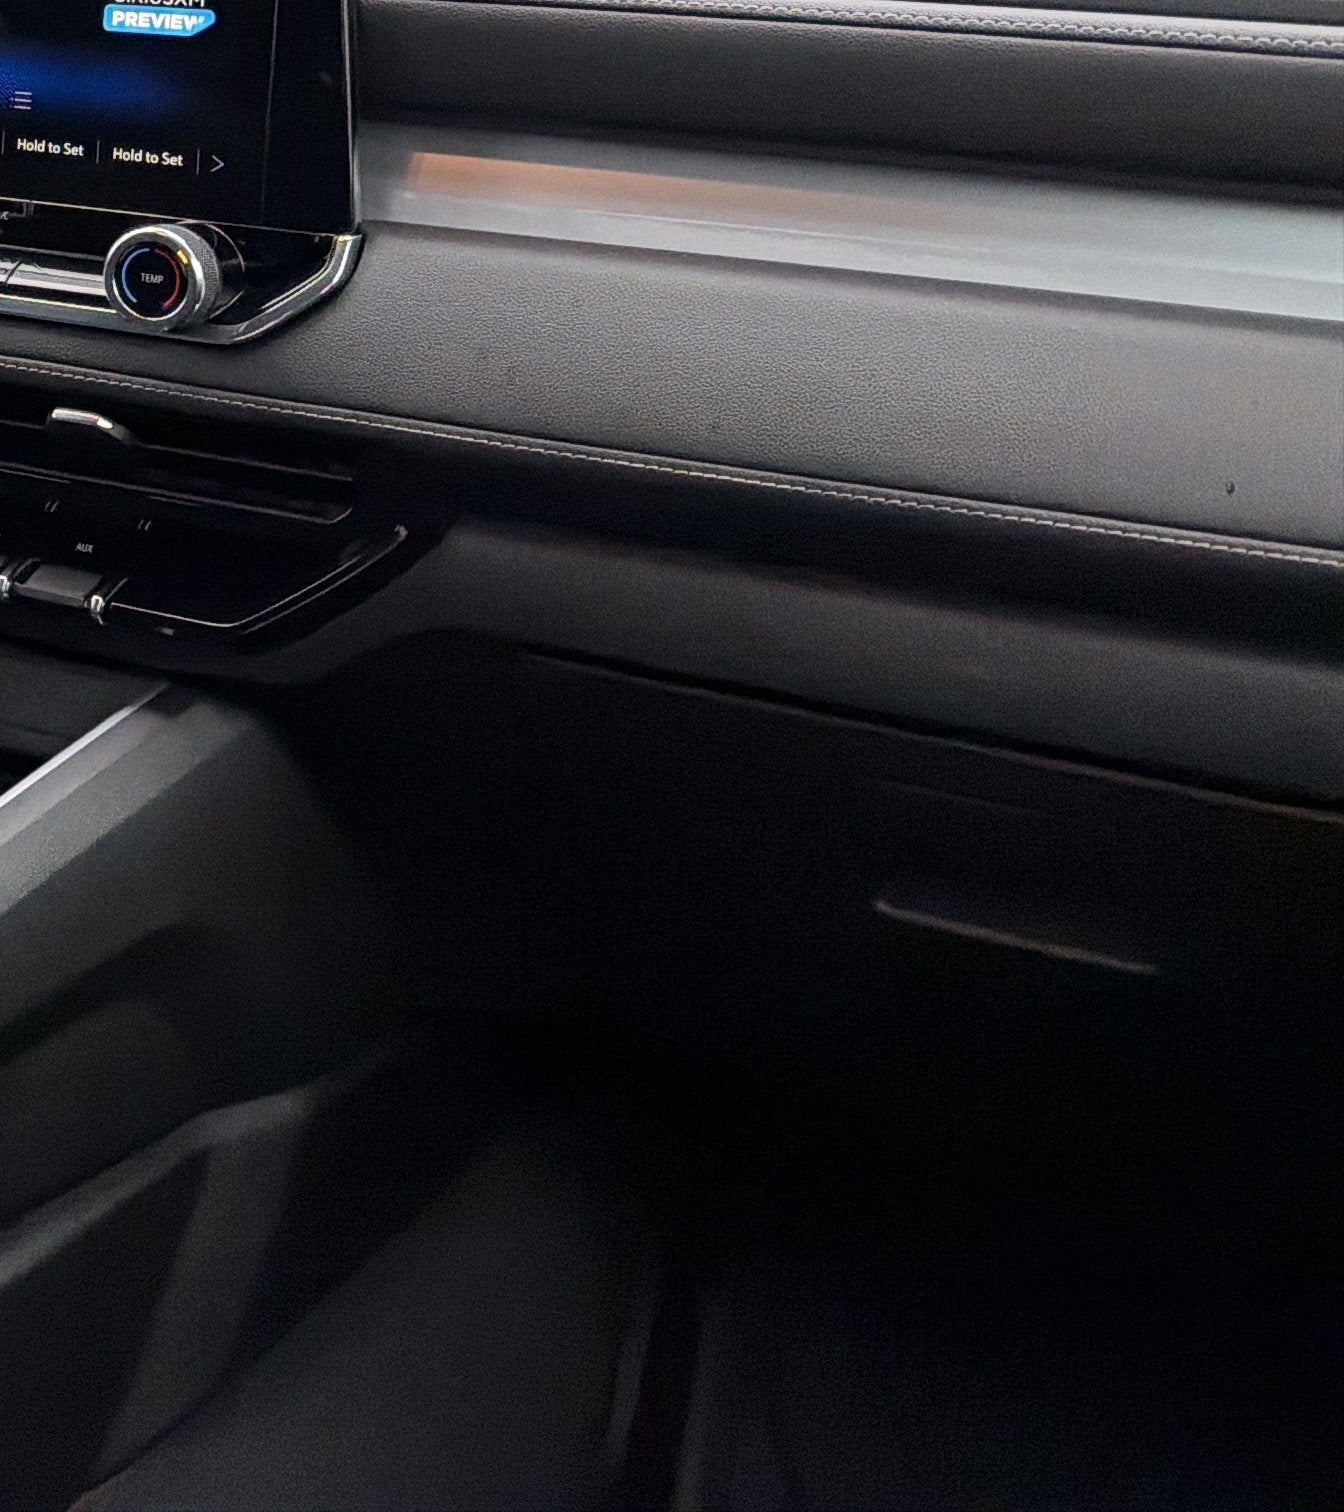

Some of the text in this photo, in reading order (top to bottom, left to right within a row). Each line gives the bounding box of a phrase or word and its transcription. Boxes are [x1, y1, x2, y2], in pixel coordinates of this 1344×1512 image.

[111, 10, 205, 31] PREVIEW
[16, 138, 85, 157] Hold to Set
[112, 147, 184, 167] Hold to Set
[140, 272, 165, 285] TEMP
[74, 542, 94, 554] AUX
